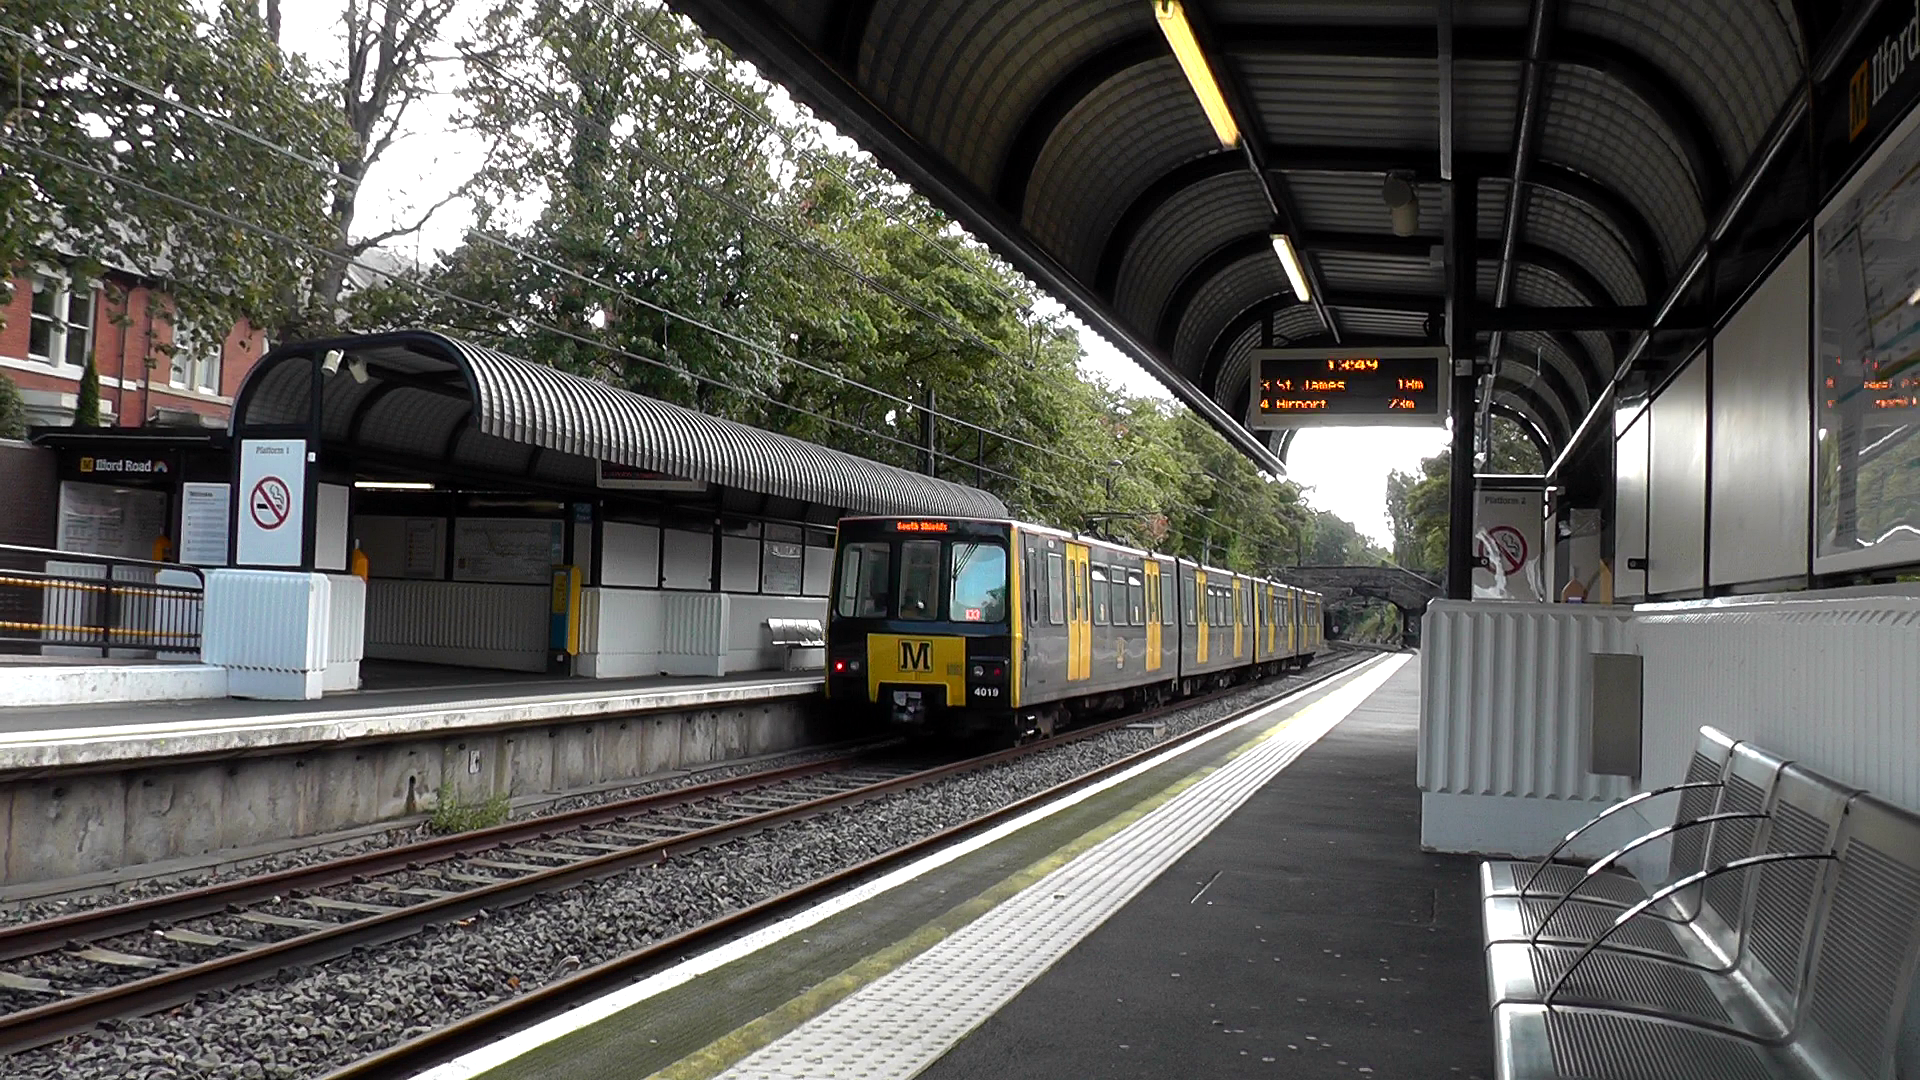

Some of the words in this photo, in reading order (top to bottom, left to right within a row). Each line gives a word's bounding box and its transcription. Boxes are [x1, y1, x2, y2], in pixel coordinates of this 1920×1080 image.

[1260, 399, 1269, 409] 4
[256, 446, 284, 454] Platform
[96, 459, 123, 472] Ilford
[125, 460, 152, 472] Road
[1485, 496, 1520, 505] Platform
[1521, 496, 1527, 505] 2
[897, 521, 919, 531] South
[920, 522, 948, 531] Shields
[901, 642, 930, 670] M
[974, 687, 999, 697] 4019
